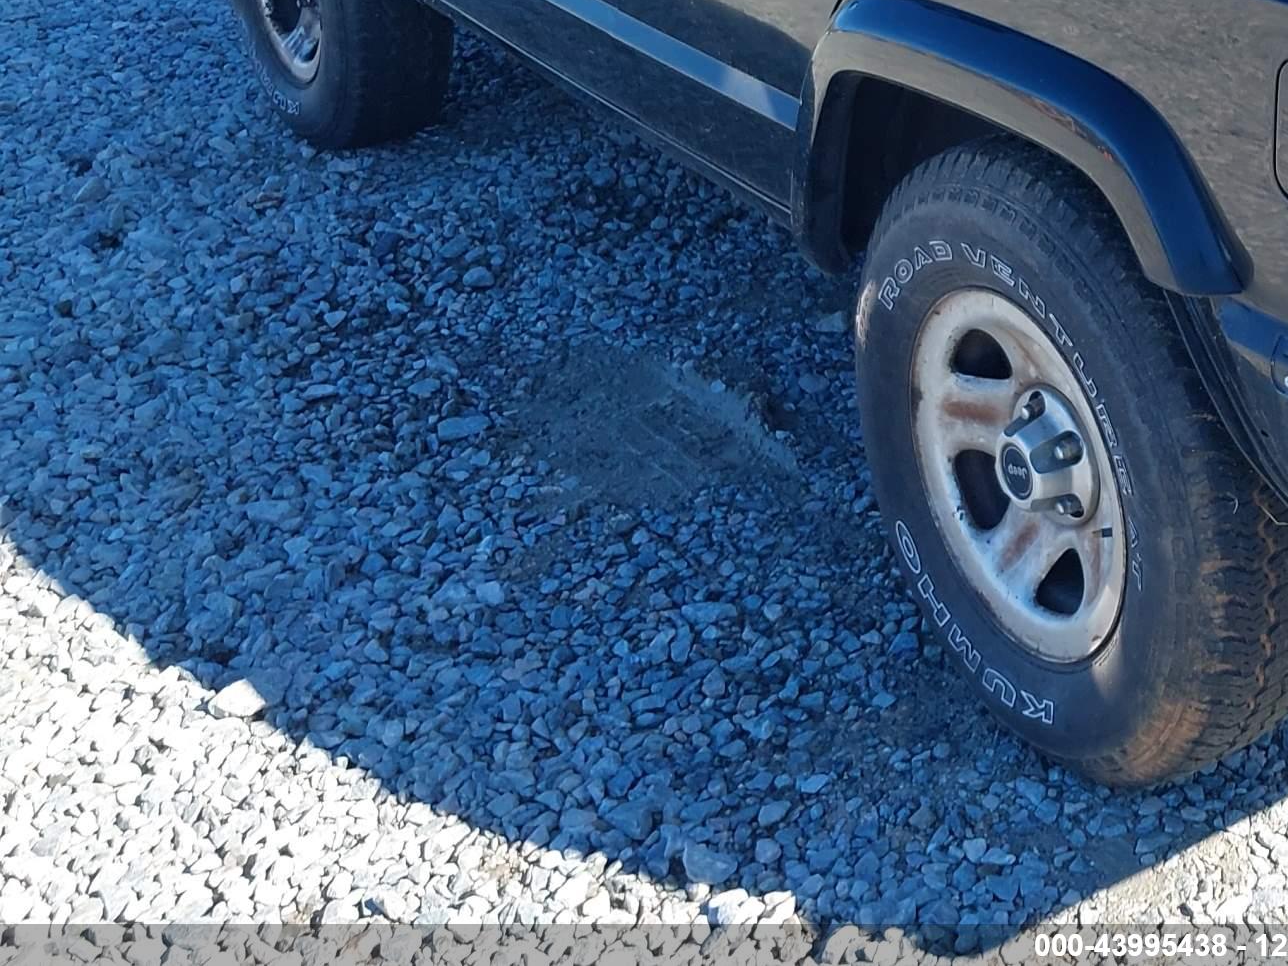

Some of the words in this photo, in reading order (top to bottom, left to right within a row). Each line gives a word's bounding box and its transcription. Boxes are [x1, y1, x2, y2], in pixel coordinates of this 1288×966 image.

[877, 240, 954, 311] ROAD
[960, 240, 1135, 497] VENTURE
[895, 520, 1055, 725] KUMHO
